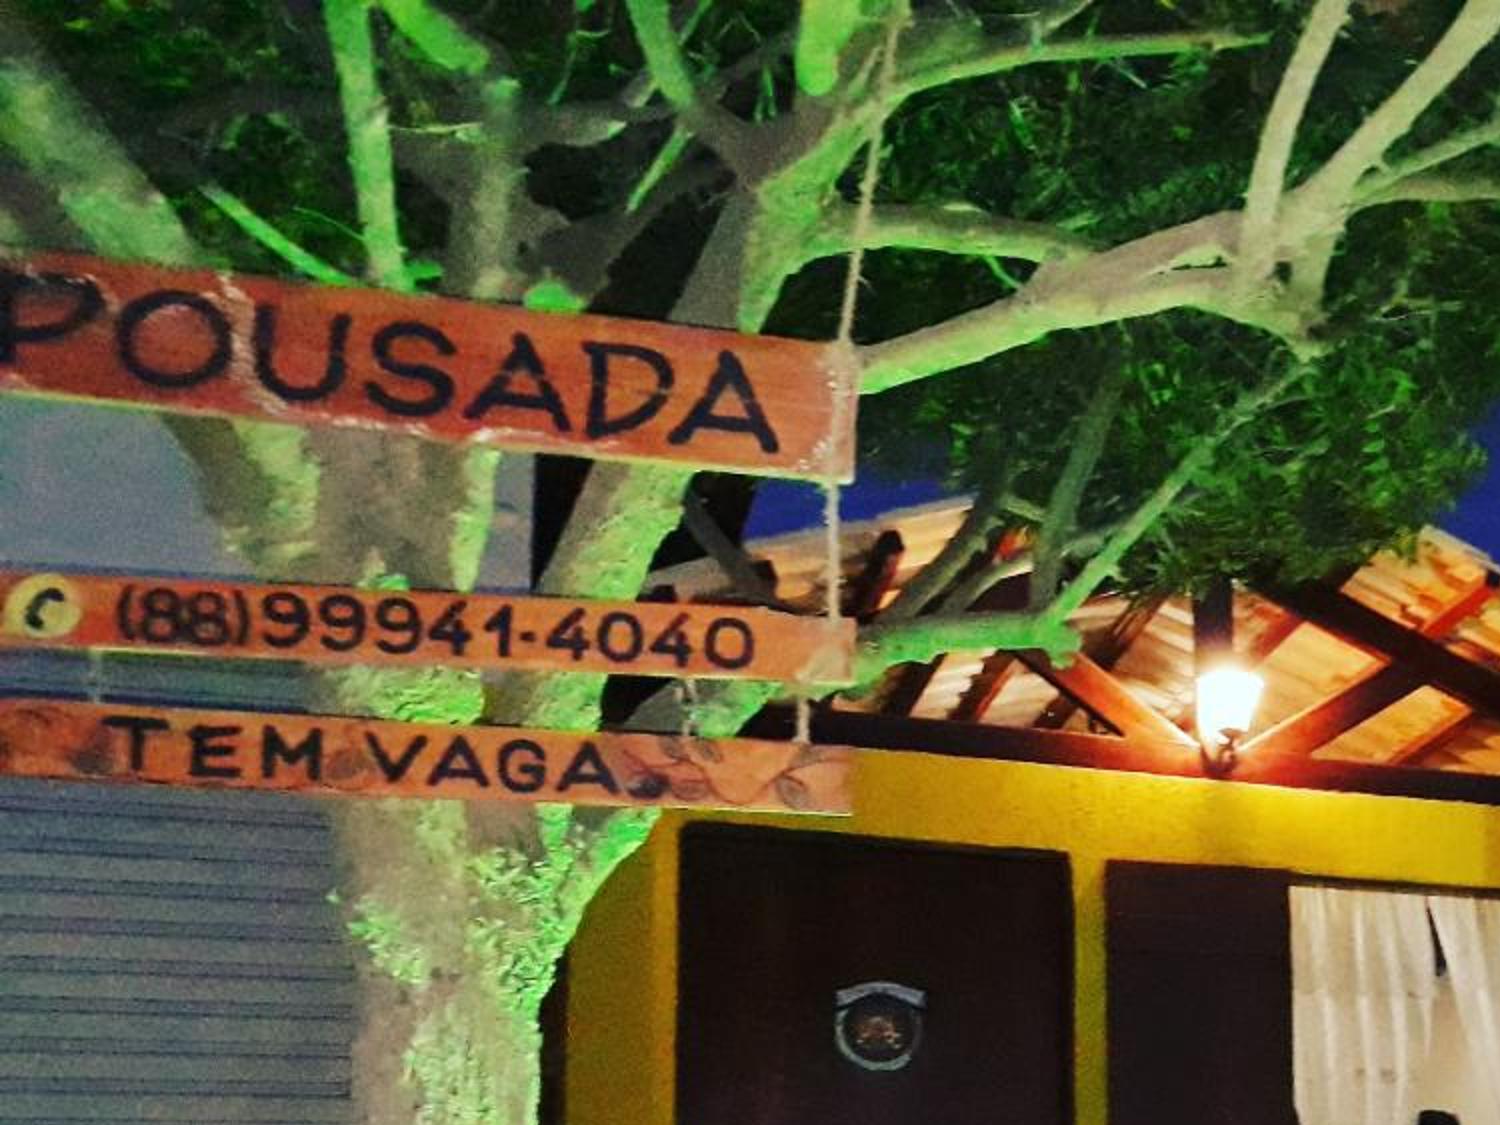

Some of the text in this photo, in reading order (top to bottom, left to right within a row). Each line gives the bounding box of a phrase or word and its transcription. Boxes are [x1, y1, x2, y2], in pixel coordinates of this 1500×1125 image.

[0, 270, 779, 454] POUSADA
[101, 713, 620, 796] TEM VAGA
